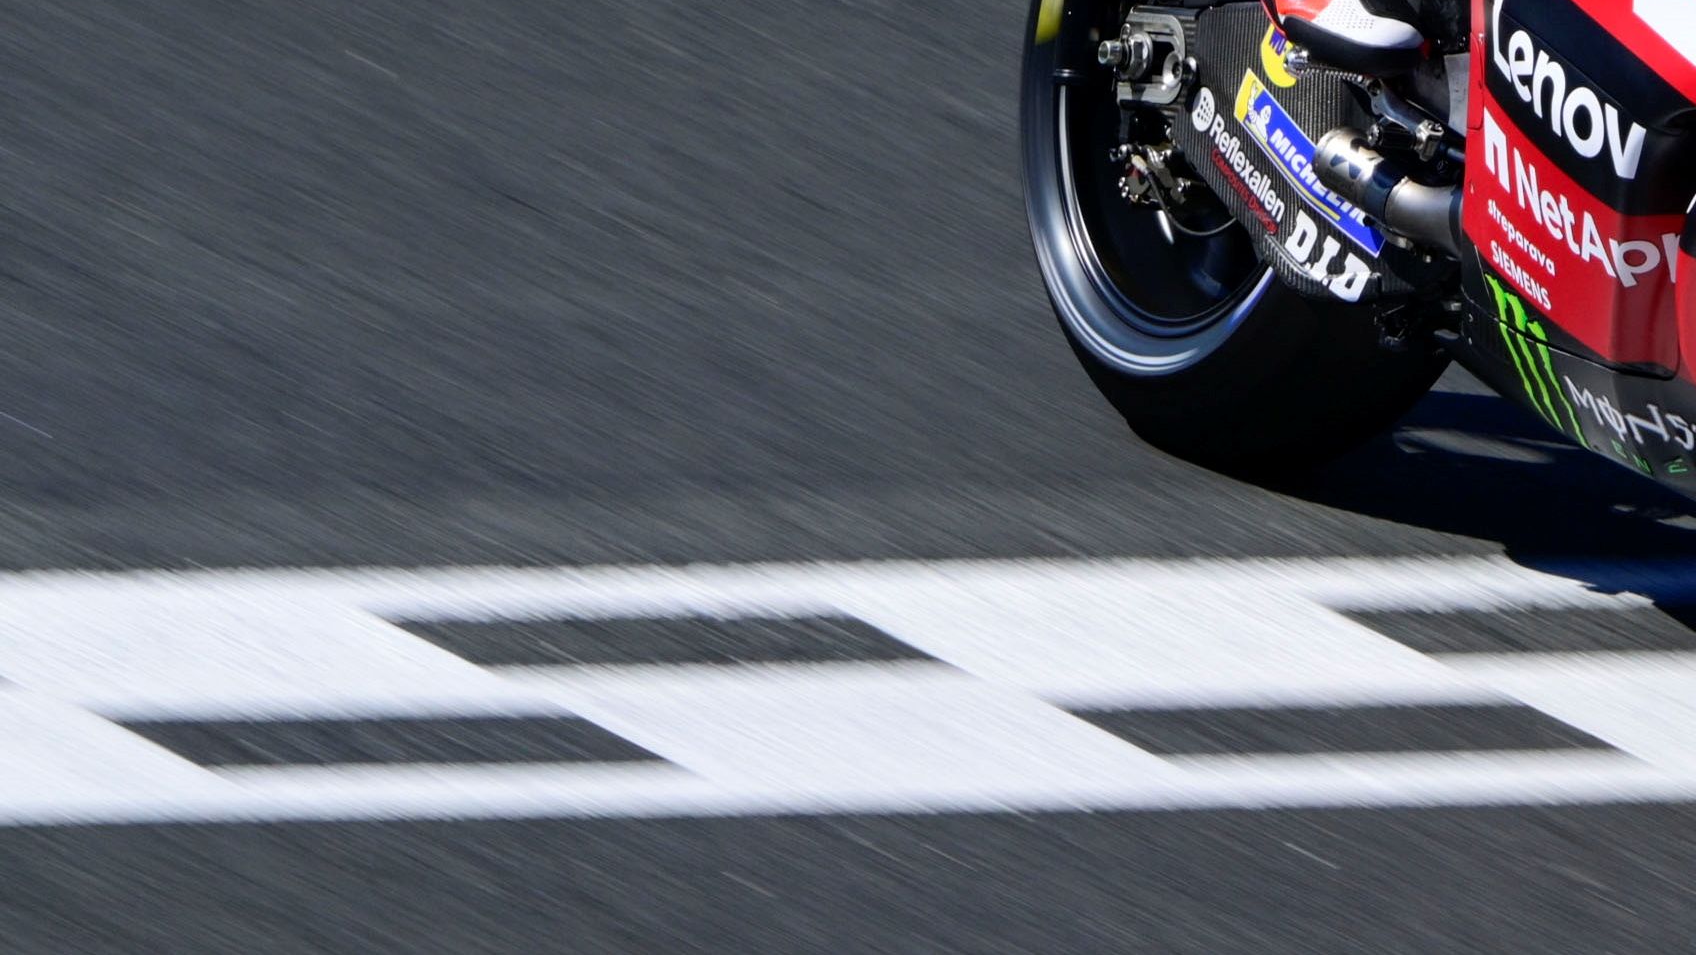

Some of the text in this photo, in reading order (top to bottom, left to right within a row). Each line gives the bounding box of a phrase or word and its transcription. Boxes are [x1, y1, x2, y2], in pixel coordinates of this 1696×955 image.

[1210, 113, 1286, 223] Reflexallen
[1269, 128, 1368, 228] MICHELIN
[1488, 198, 1556, 277] streparava
[1491, 240, 1552, 312] SIEMENS
